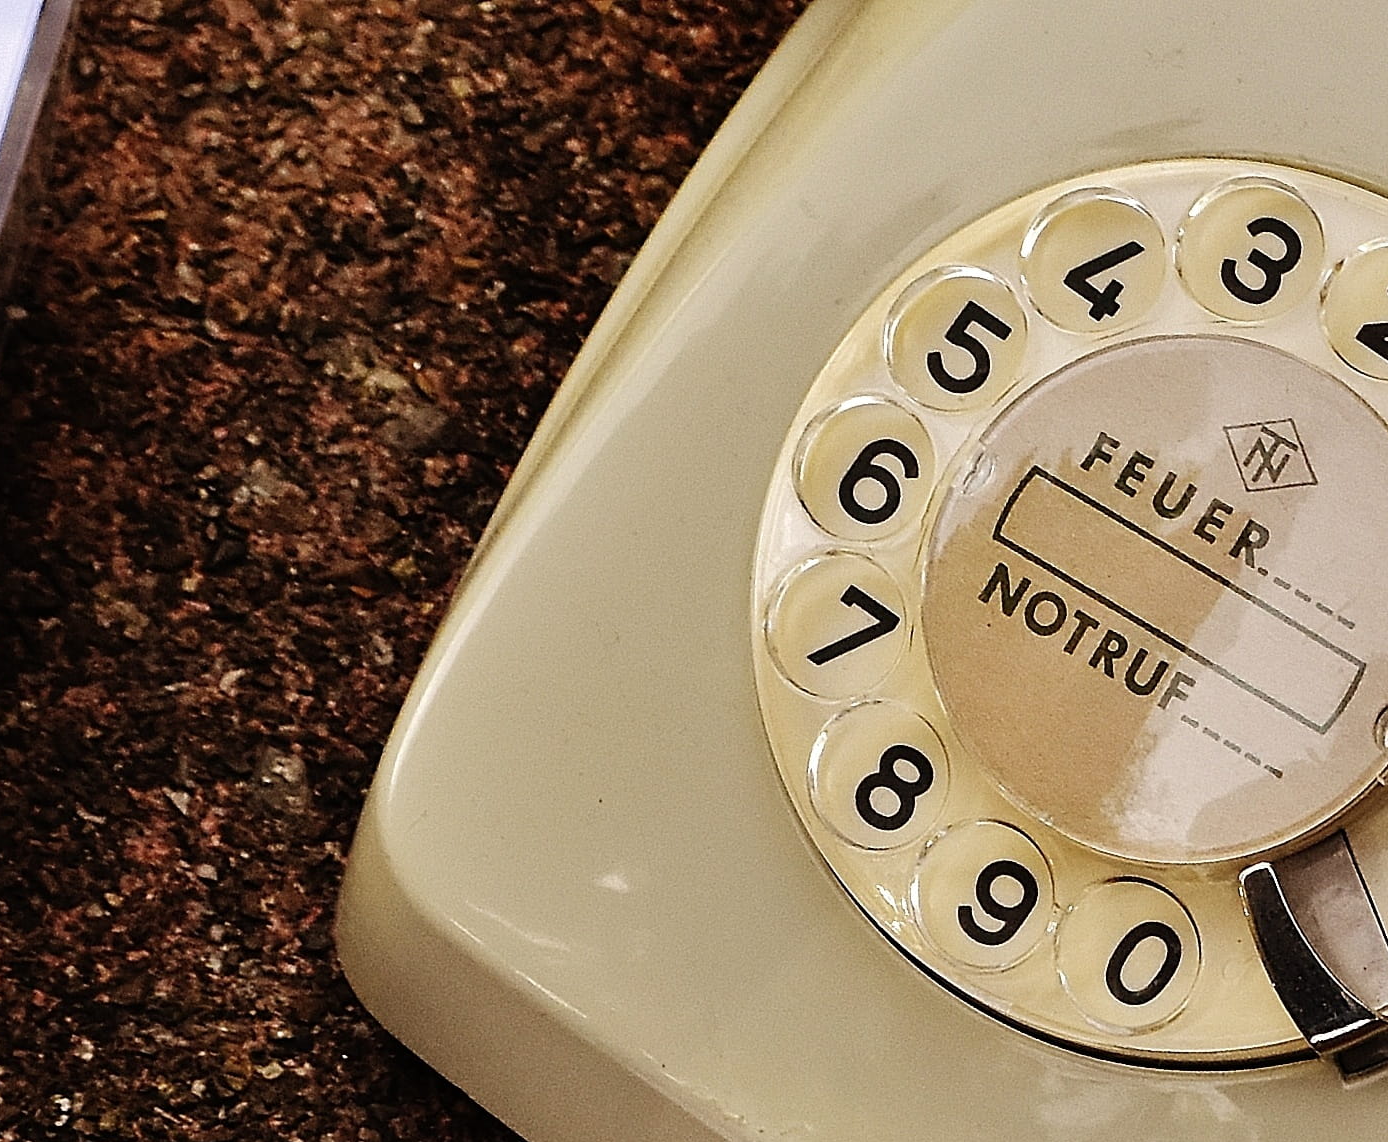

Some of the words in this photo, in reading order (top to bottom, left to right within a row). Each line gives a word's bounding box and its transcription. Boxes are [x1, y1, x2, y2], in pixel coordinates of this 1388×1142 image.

[1063, 240, 1145, 322] 4
[1220, 217, 1302, 305] 3
[925, 300, 1013, 394] 5
[838, 437, 919, 525] 6
[1079, 432, 1271, 569] FEUER
[806, 584, 900, 666] 7
[978, 562, 1197, 710] NOTRUF
[854, 744, 934, 831] 8
[957, 859, 1039, 946] 9
[1104, 920, 1182, 1006] 0
